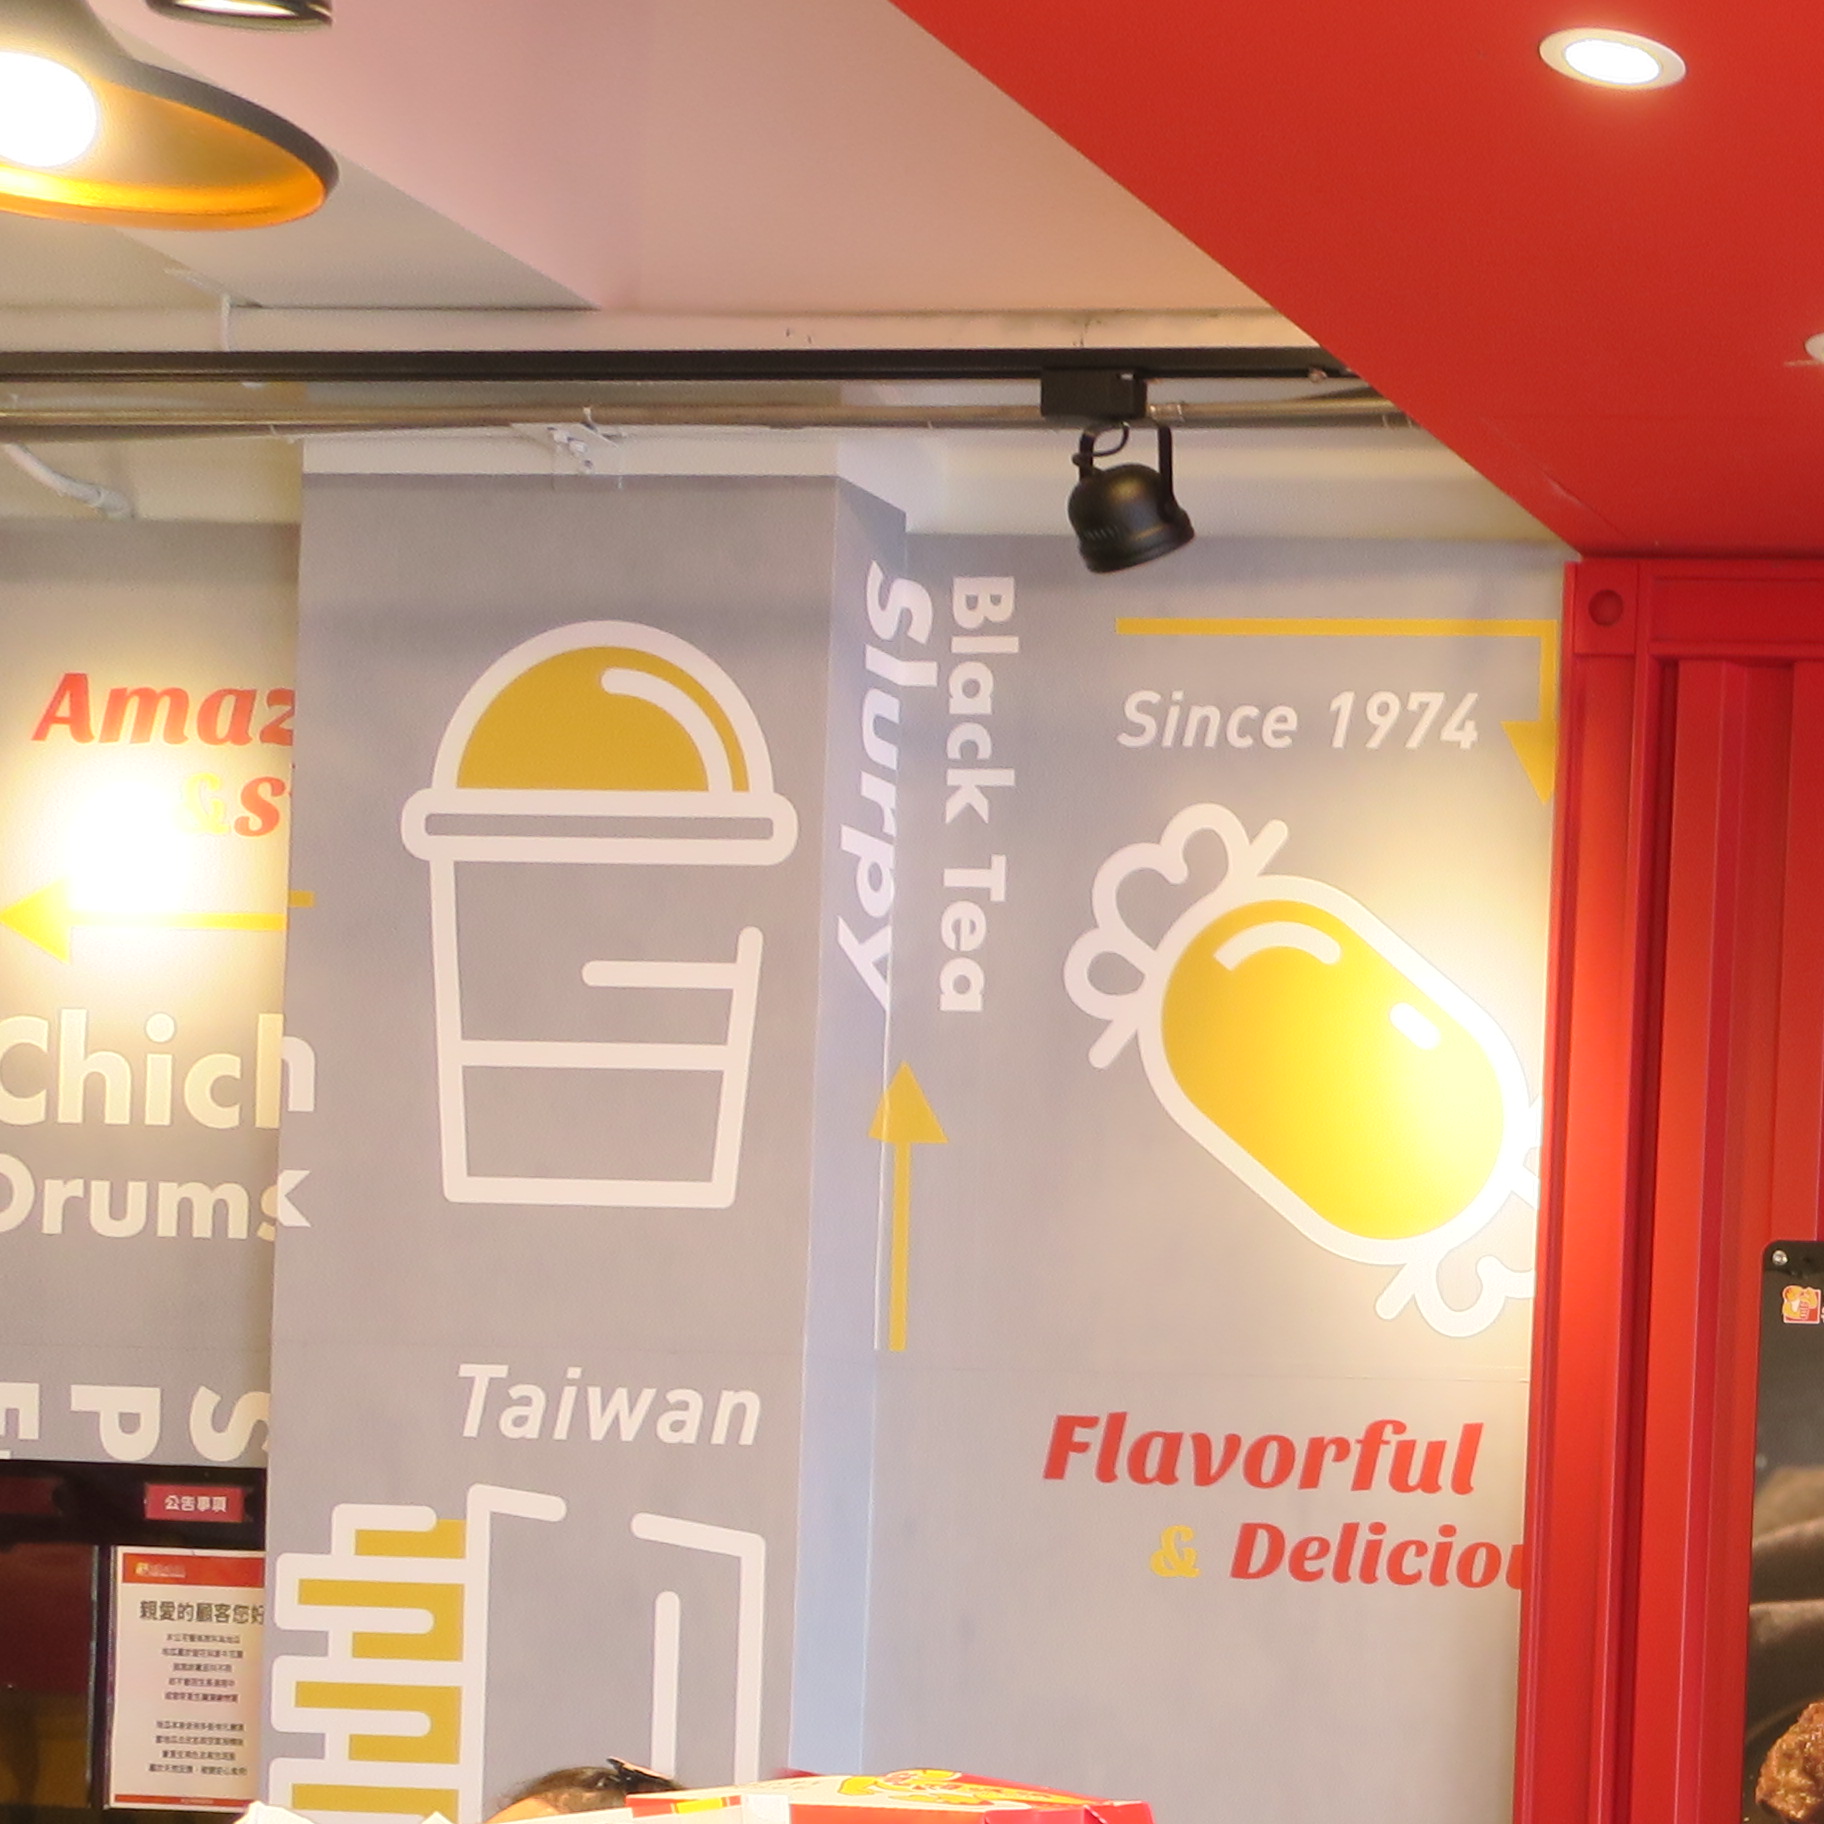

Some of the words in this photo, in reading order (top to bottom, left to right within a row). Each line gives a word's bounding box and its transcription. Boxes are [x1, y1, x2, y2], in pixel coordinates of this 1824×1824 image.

[944, 576, 1019, 823] Black
[1116, 690, 1298, 749] Since
[1329, 692, 1479, 751] 1974
[837, 561, 938, 1012] Slurpy
[939, 855, 1006, 1012] Tea
[457, 1363, 762, 1446] Taiwan
[1043, 1411, 1484, 1496] Flavorful
[1149, 1524, 1200, 1578] &
